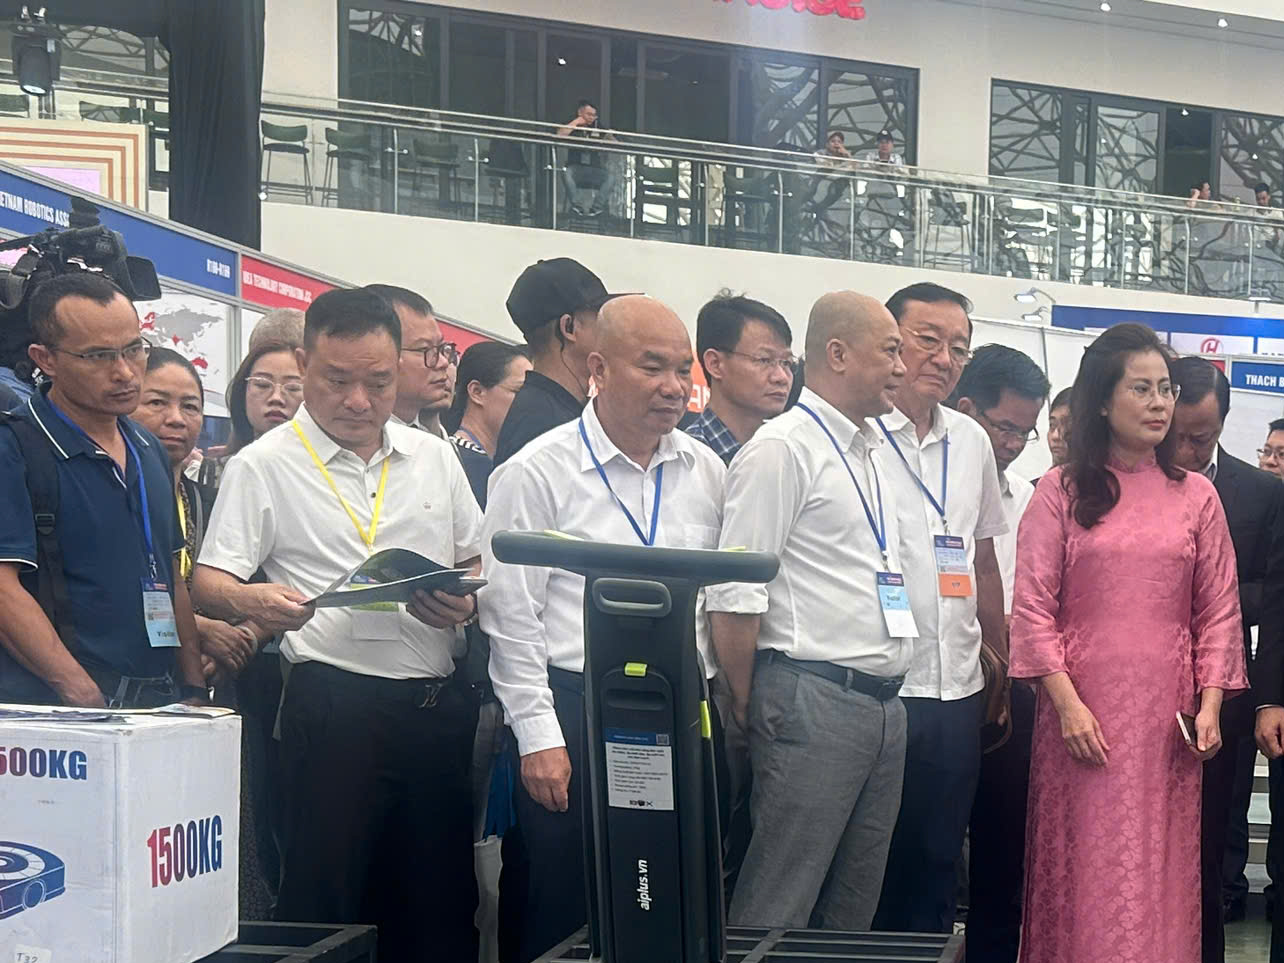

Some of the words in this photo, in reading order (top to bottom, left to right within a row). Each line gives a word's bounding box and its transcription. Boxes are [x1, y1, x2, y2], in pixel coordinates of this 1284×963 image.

[1245, 374, 1277, 387] THACH
[147, 815, 223, 888] 1500KG
[637, 859, 652, 911] aiplus.vn
